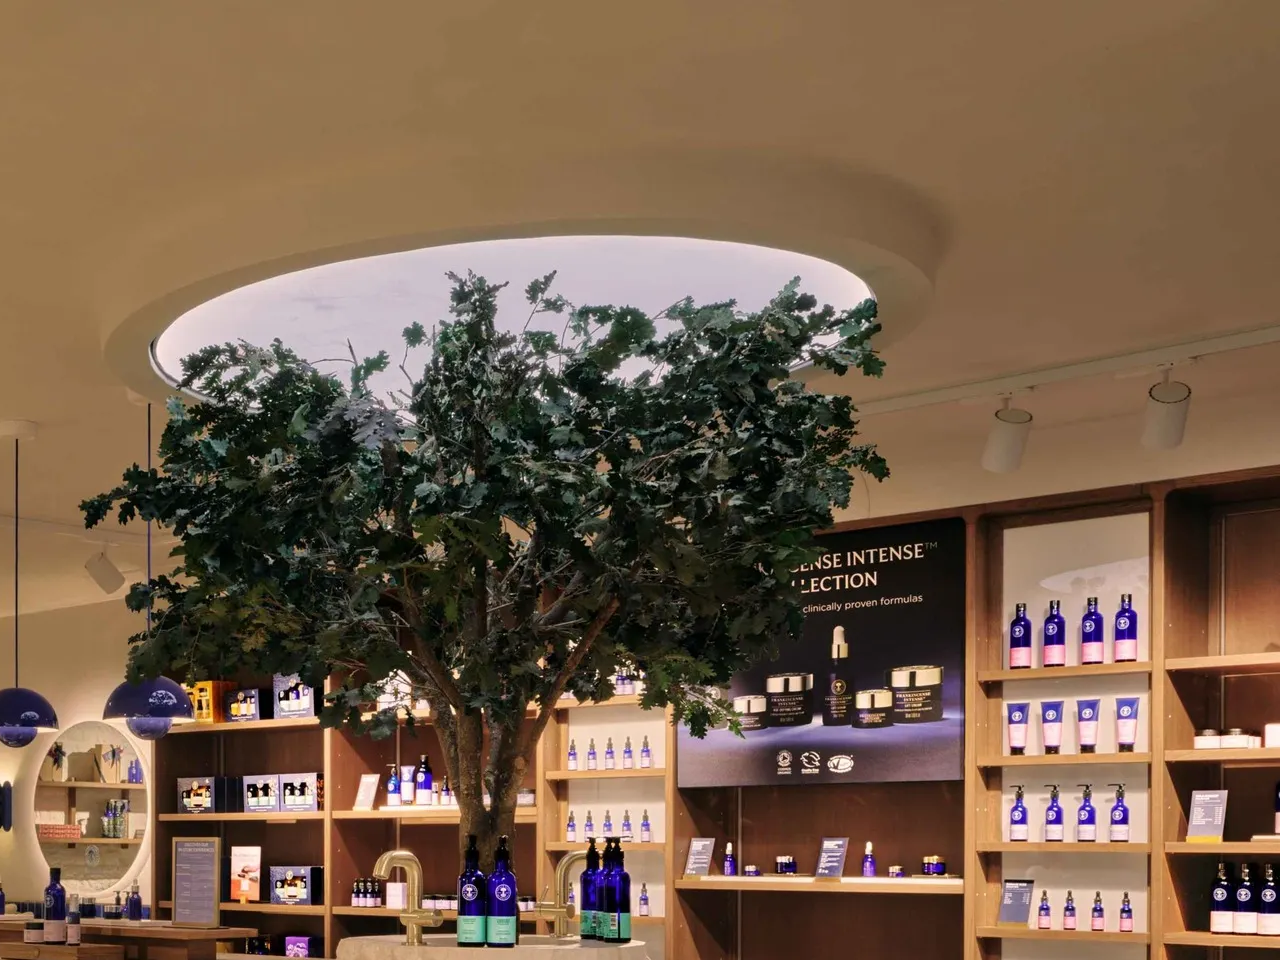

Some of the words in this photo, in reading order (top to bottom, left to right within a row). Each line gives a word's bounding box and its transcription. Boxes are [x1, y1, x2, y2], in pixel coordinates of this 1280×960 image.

[802, 602, 842, 614] clinically
[844, 599, 878, 611] proven
[880, 594, 923, 606] formulas
